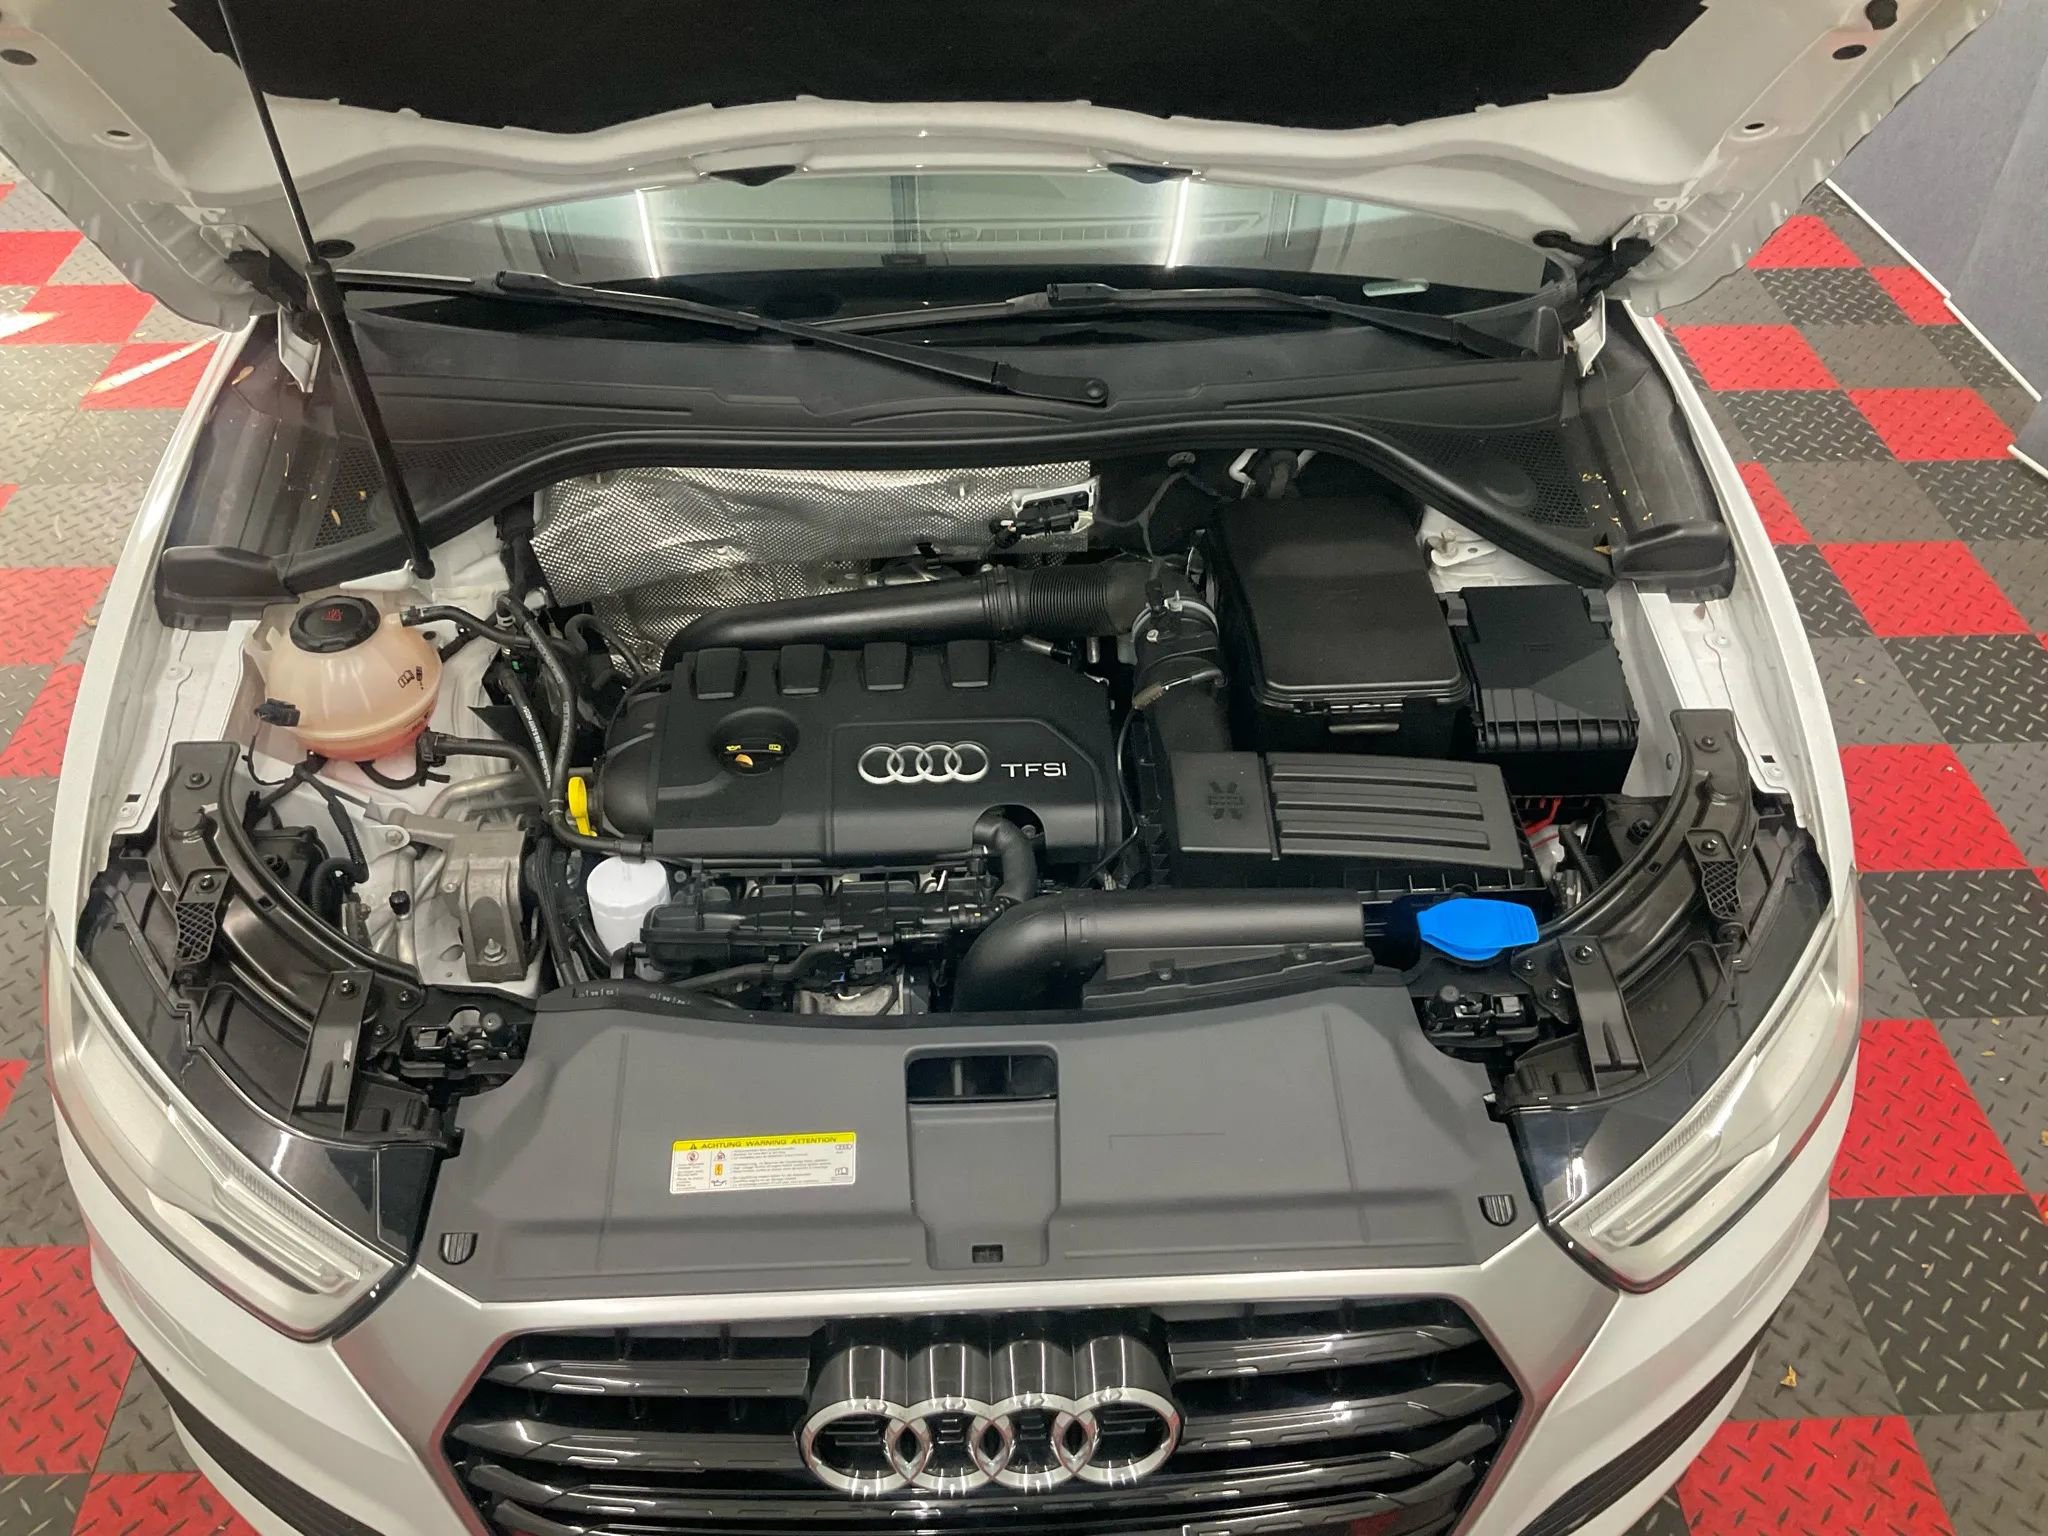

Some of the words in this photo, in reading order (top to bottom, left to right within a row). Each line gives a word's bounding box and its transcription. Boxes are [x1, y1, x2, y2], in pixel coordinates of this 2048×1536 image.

[1000, 762, 1067, 777] TFSI
[745, 1139, 787, 1147] WARNING
[790, 1137, 837, 1145] ATTENTION
